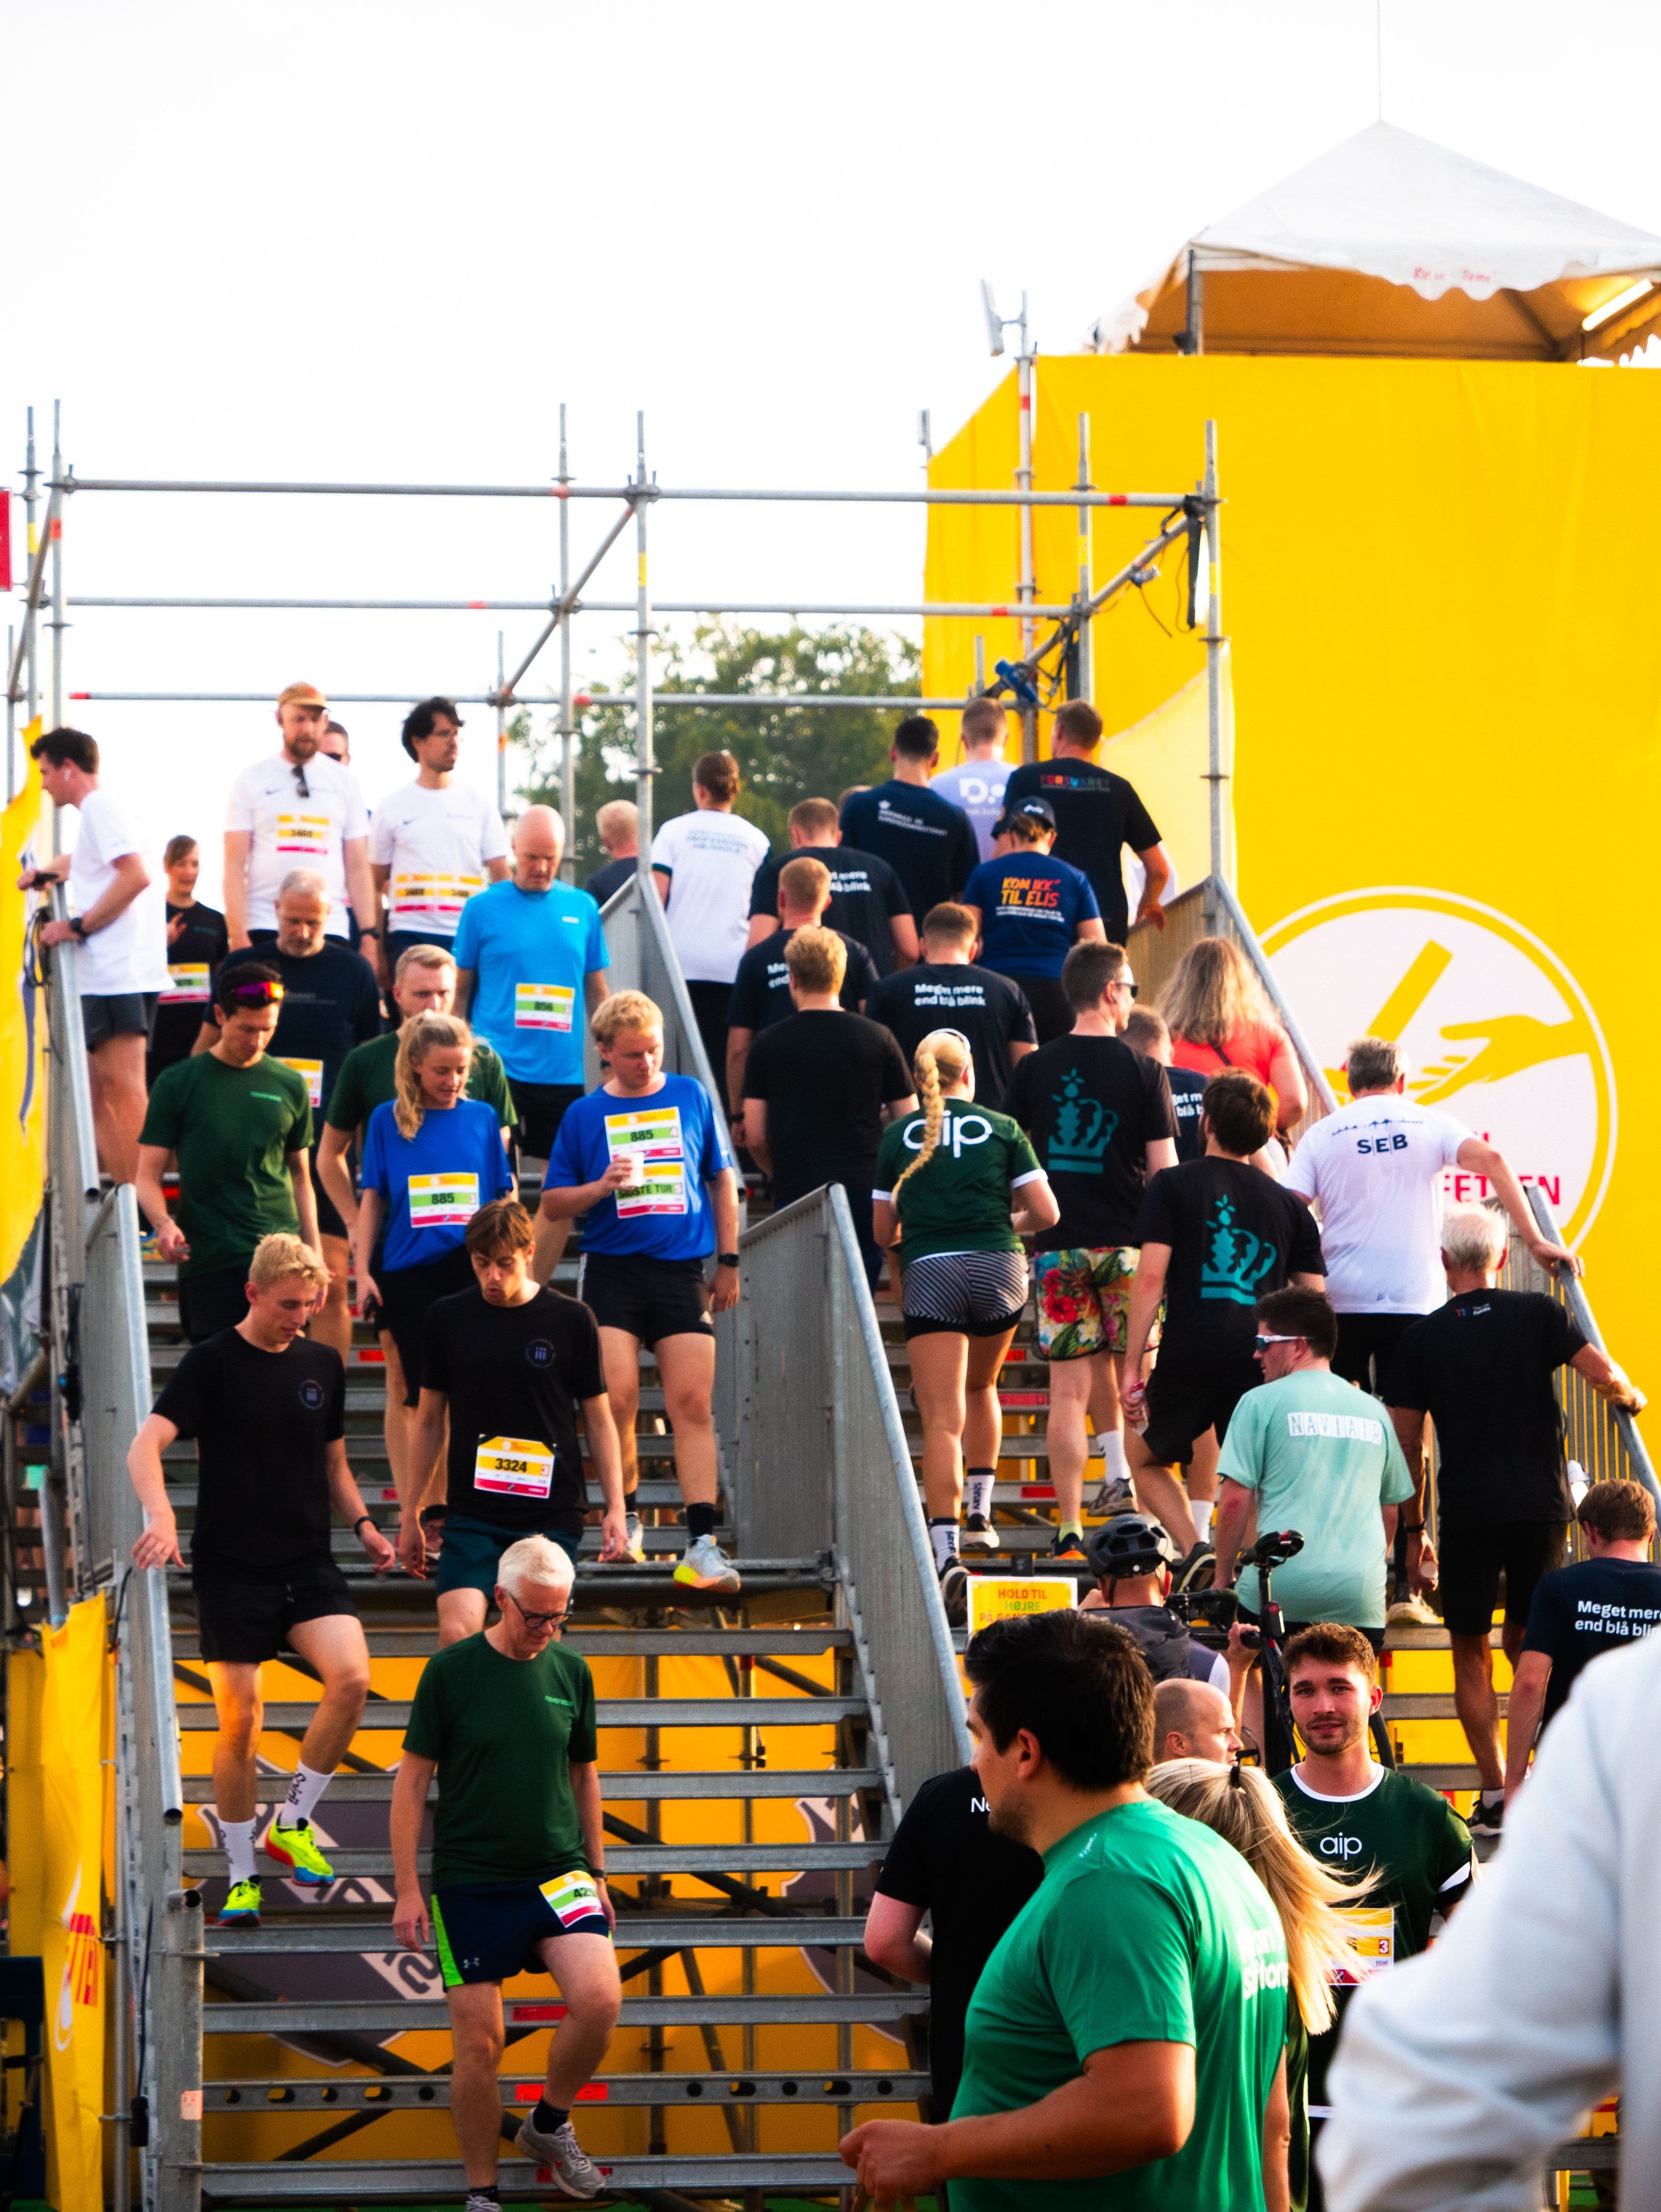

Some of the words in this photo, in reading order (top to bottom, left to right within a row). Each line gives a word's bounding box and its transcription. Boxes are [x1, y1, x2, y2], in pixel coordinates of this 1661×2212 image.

[1001, 890, 1023, 905] TIL
[1025, 890, 1060, 908] ELIS
[952, 986, 984, 995] mere
[914, 995, 938, 1006] end
[939, 995, 956, 1007] blå
[957, 995, 987, 1006] blink
[1176, 1104, 1195, 1117] blå
[631, 1130, 654, 1142] 885
[1357, 1133, 1408, 1154] SEB
[432, 1193, 454, 1204] 885
[495, 1458, 527, 1473] 3324
[998, 1589, 1028, 1599] HOLD
[1031, 1589, 1048, 1599] TIL
[1005, 1601, 1041, 1611] HØJRE
[1578, 1600, 1627, 1619] Meget
[1575, 1619, 1603, 1633] end
[1606, 1620, 1629, 1636] blå
[1632, 1623, 1653, 1637] bli
[1319, 1832, 1362, 1860] aip
[1379, 1940, 1389, 1953] 3
